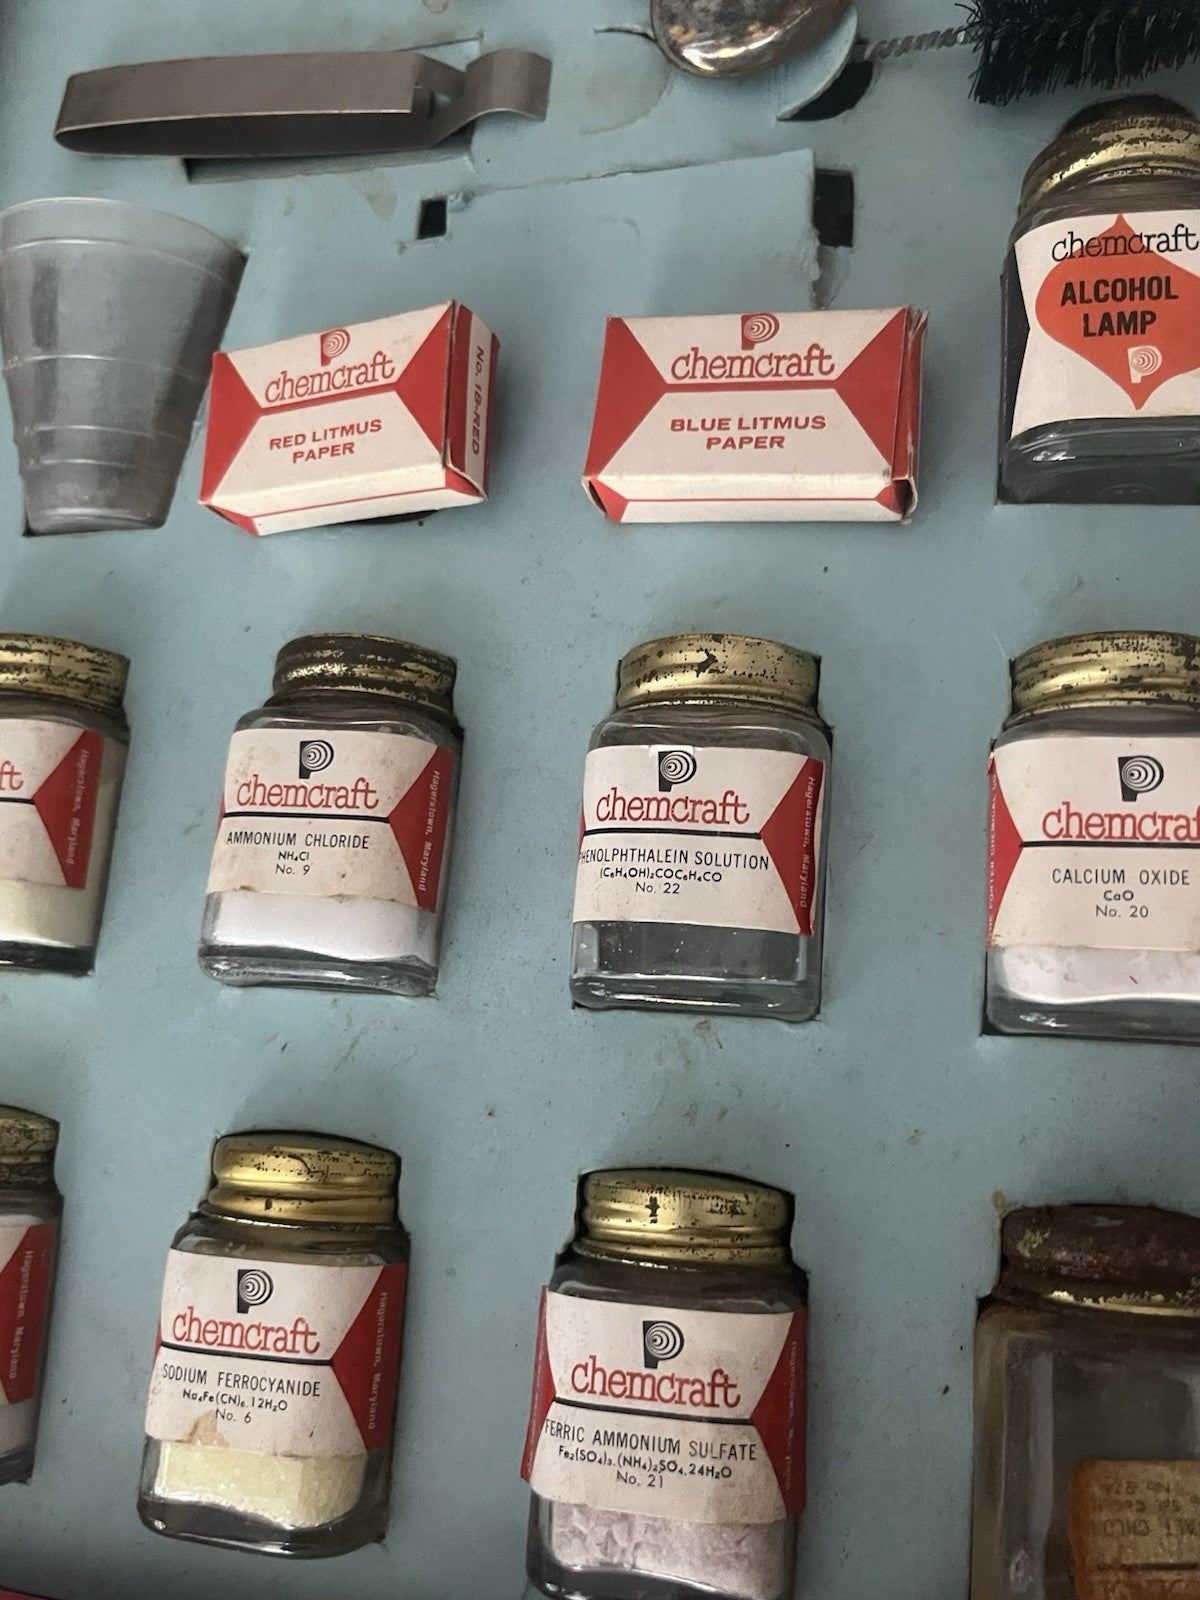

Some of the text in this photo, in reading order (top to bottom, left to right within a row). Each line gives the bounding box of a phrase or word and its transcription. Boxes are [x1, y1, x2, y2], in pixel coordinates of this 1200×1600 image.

[1052, 223, 1200, 262] chemcraft
[1060, 276, 1179, 307] ALCOHOL
[1083, 311, 1157, 337] LAMP
[671, 343, 835, 380] chemcraft
[265, 350, 396, 403] chemcraft
[269, 419, 383, 450] RED LITMUS
[670, 416, 826, 432] BLUE LITMUS
[292, 442, 355, 463] PAPER
[706, 436, 785, 450] PAPER
[237, 774, 379, 810] chemcraft
[596, 787, 750, 825] chemcraft
[226, 832, 370, 850] AMMONIUM CHLORIDE
[275, 864, 311, 875] No. 9
[419, 841, 433, 892] Maryland
[694, 851, 769, 870] SOLUTION
[635, 882, 680, 894] No. 22
[1052, 868, 1190, 885] CALCIUM OXIDE
[1103, 890, 1134, 901] CaO
[1096, 905, 1149, 918] No. 20
[173, 1306, 320, 1354] chemcraft
[163, 1363, 321, 1396] SODIUM FERROCYANIDE
[571, 1355, 741, 1408] chemcraft
[216, 1408, 251, 1423] No. 6
[545, 1418, 756, 1460] FERRIC AMMONIUM SULFATE
[616, 1470, 663, 1488] No. 21
